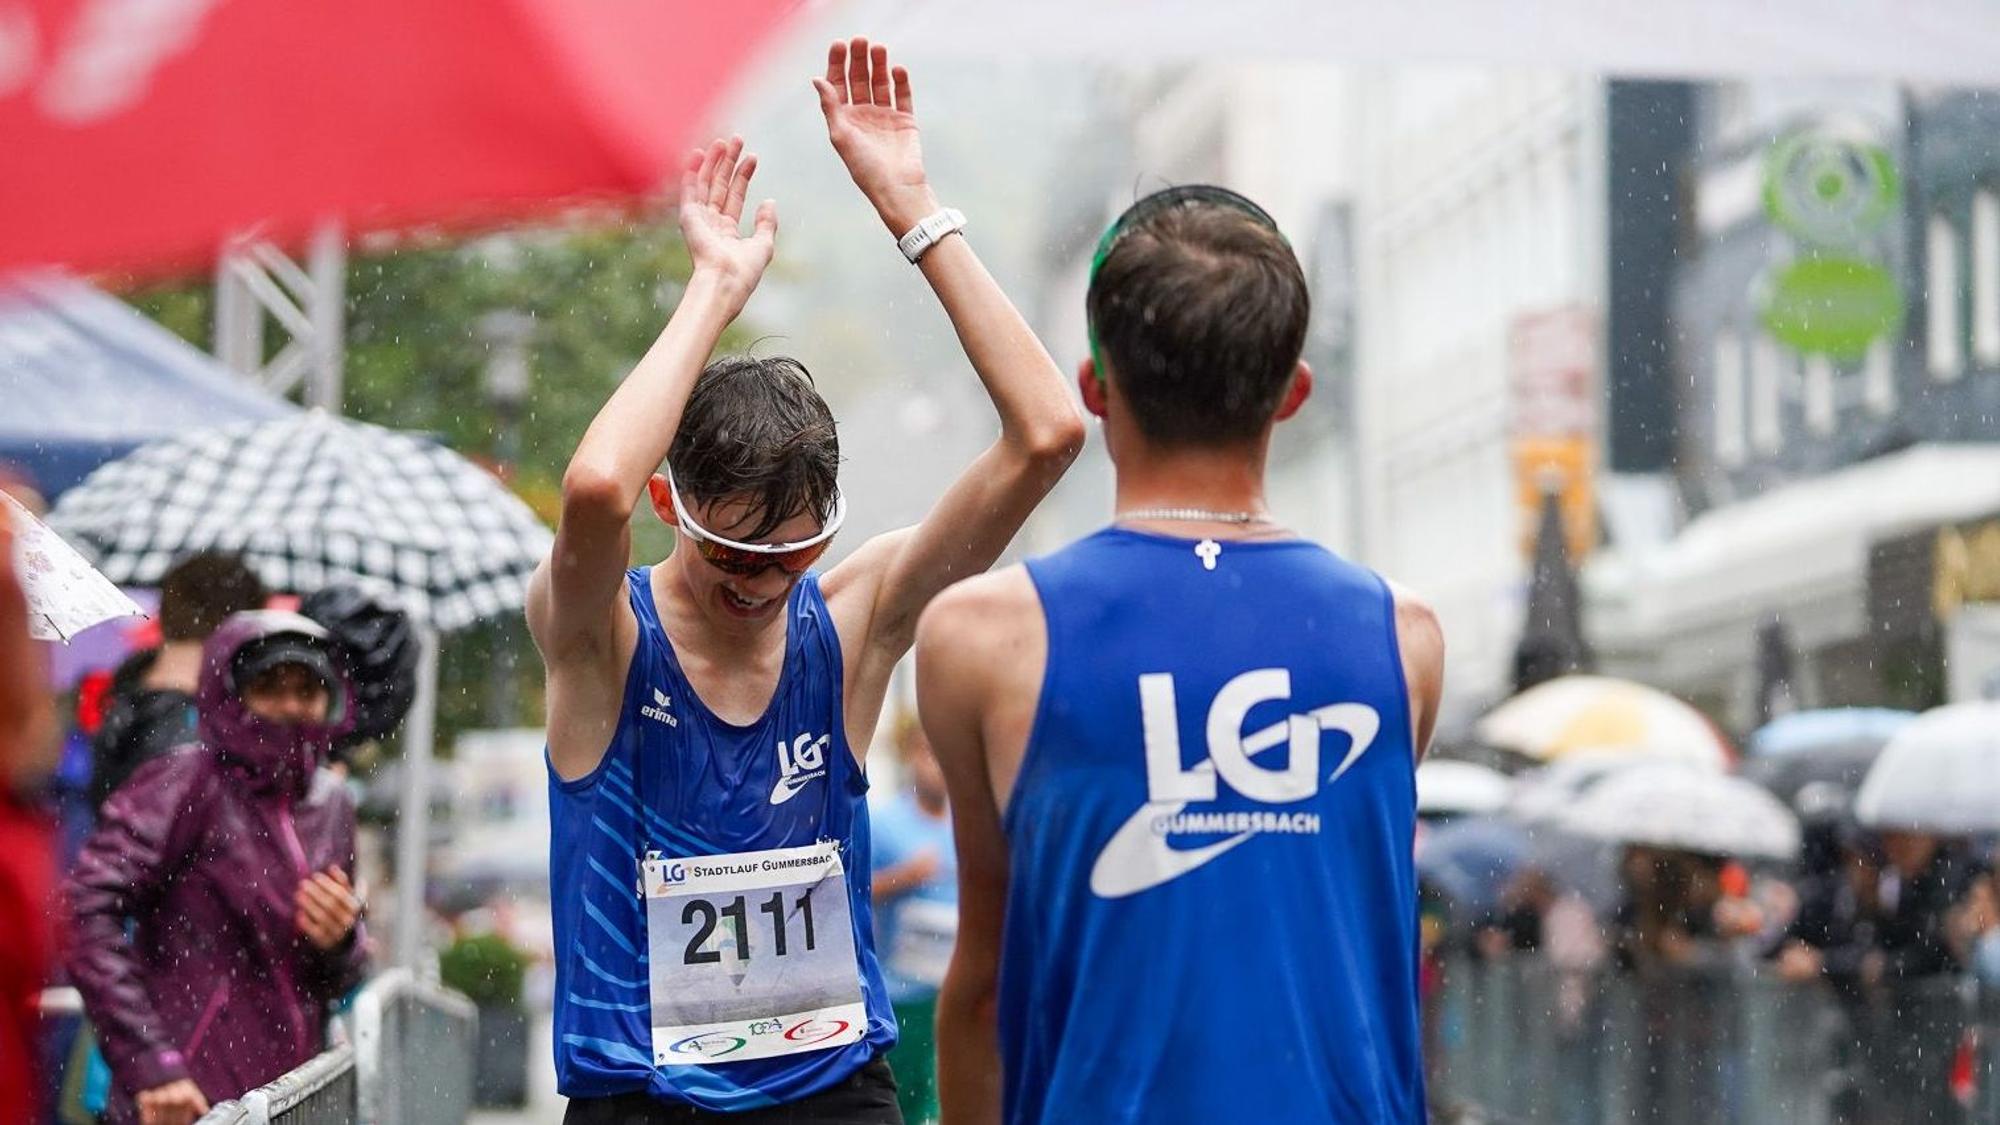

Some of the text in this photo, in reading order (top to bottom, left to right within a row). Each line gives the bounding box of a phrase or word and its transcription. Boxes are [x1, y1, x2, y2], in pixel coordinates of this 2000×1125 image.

[641, 704, 677, 728] erima
[1138, 667, 1320, 803] LG
[778, 732, 824, 776] LG
[1153, 812, 1320, 834] GUMMERSBACH
[663, 854, 832, 882] LG STADTLAUF GUMMERSBAC
[682, 888, 815, 965] 2111
